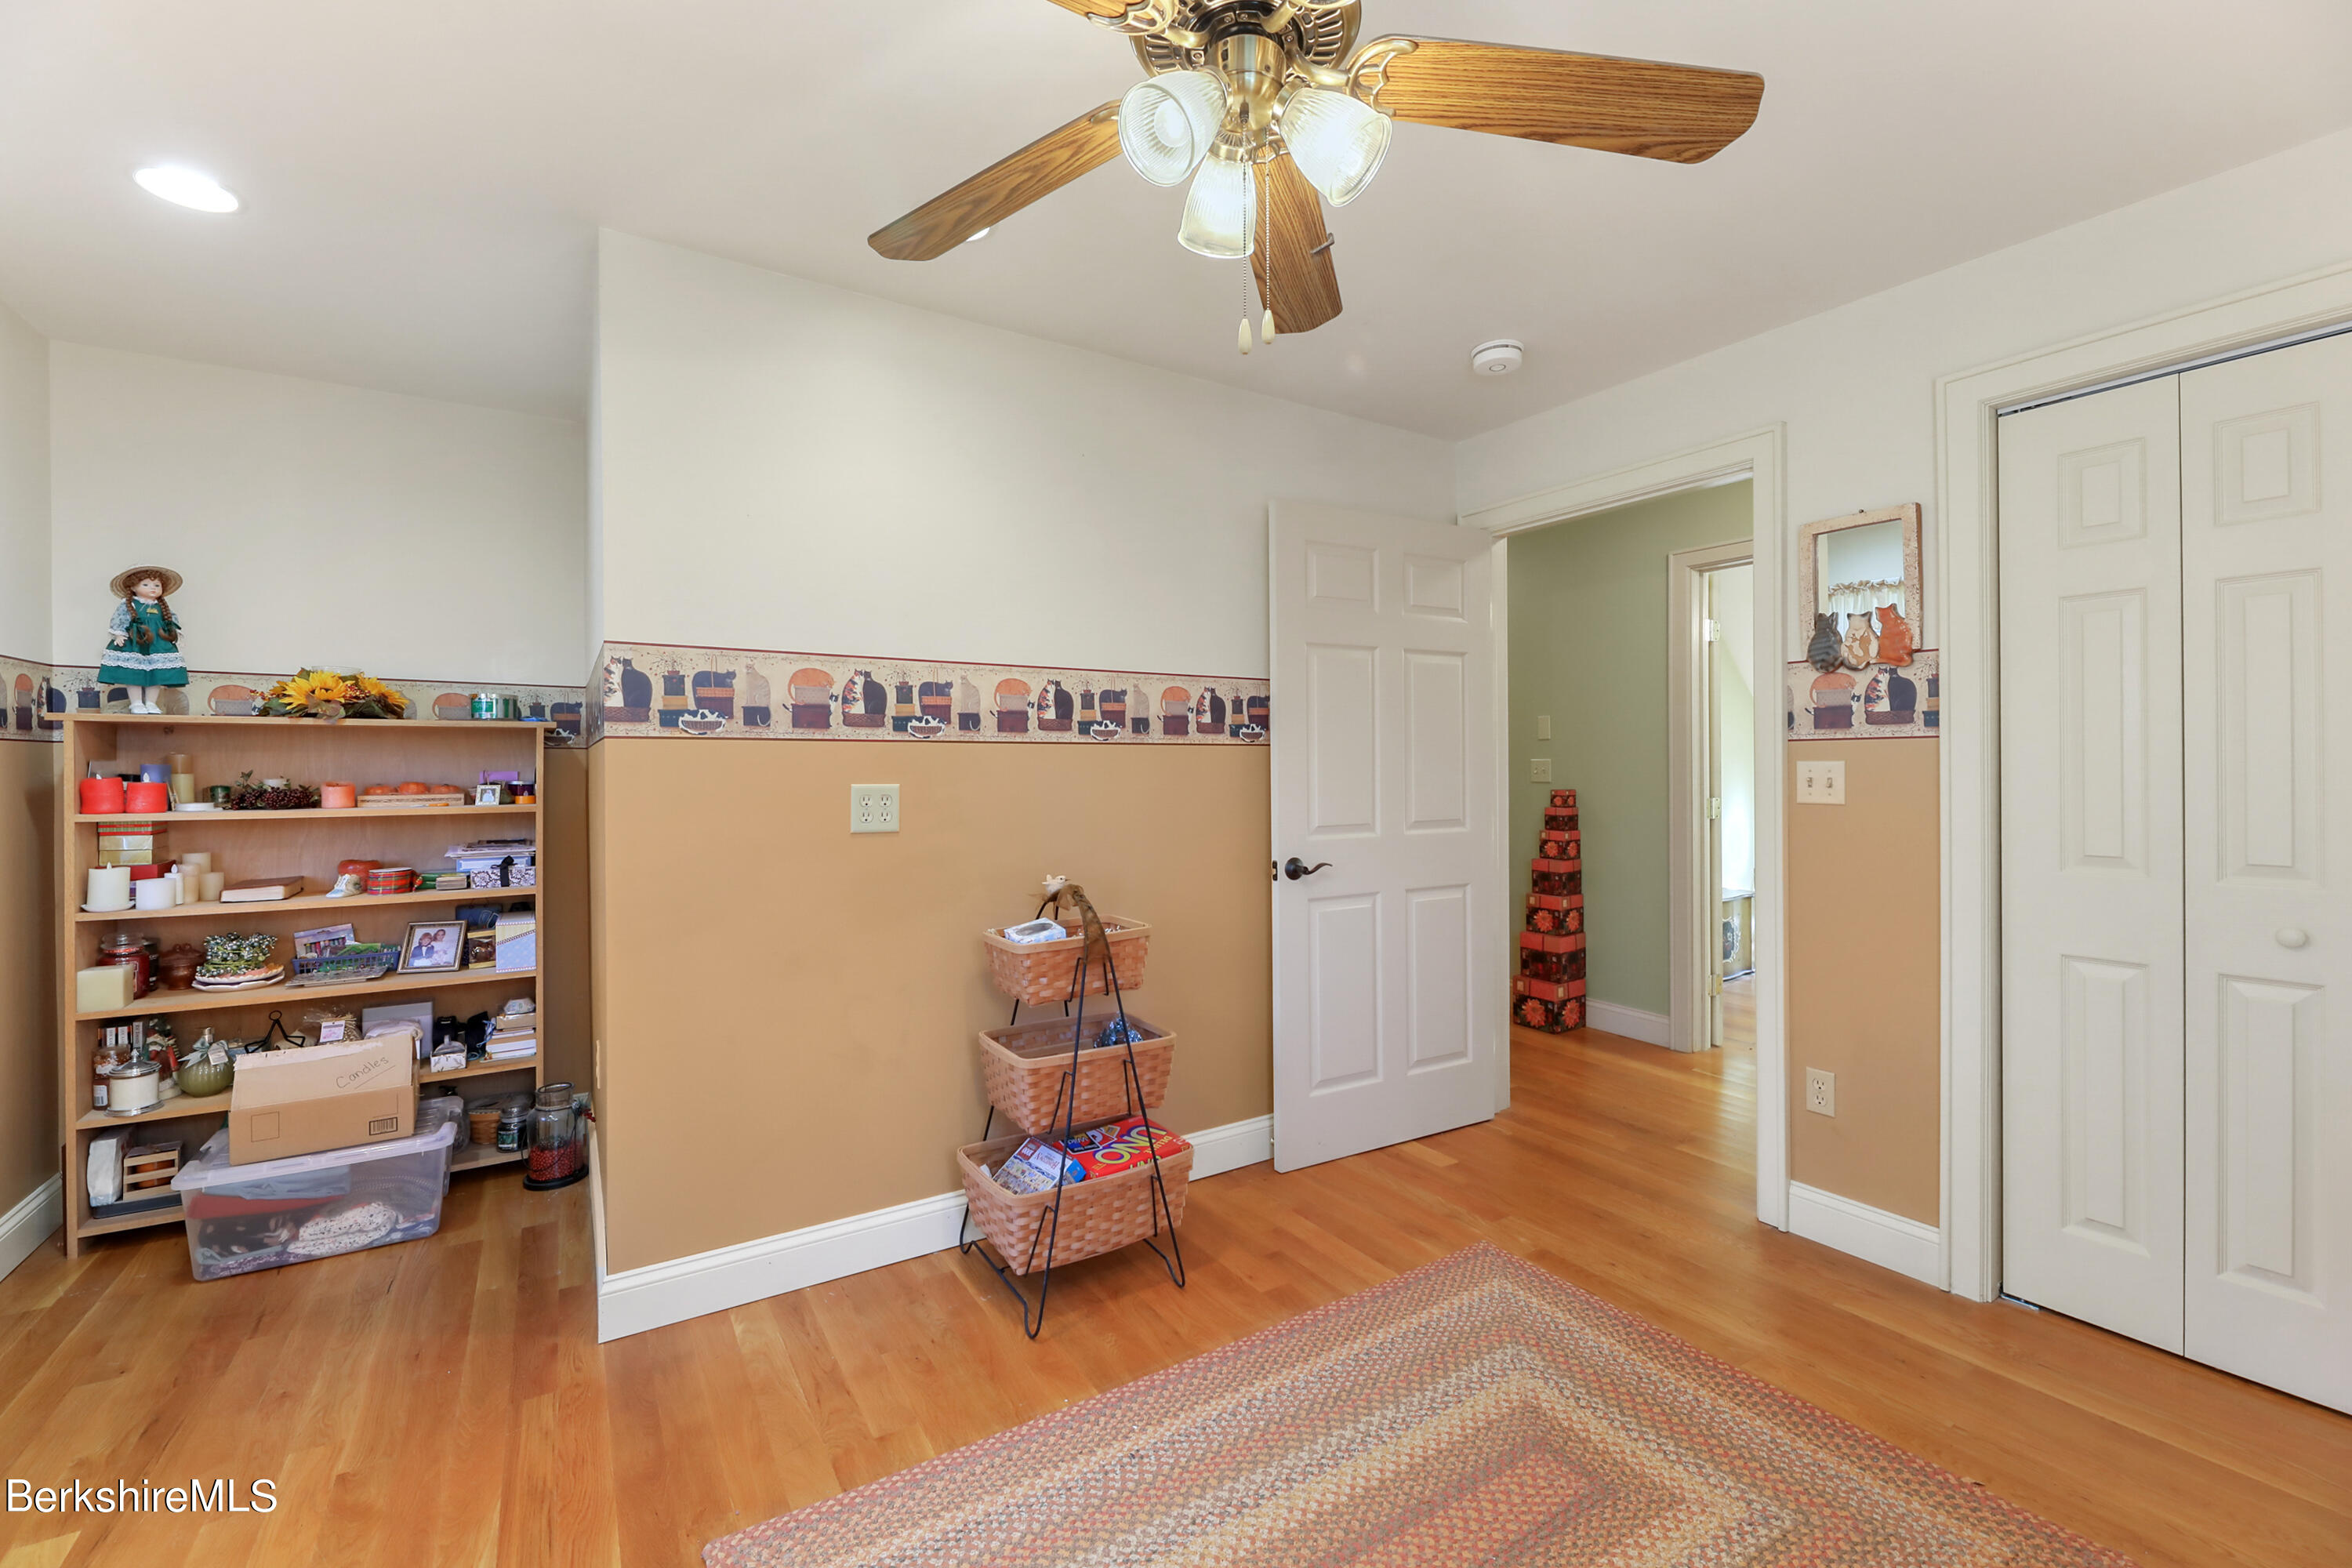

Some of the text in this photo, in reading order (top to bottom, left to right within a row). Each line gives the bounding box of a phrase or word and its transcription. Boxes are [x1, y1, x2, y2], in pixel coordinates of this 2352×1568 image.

[336, 1057, 390, 1089] Candles
[1093, 1125, 1167, 1164] UNO
[1142, 1134, 1173, 1155] DELUE
